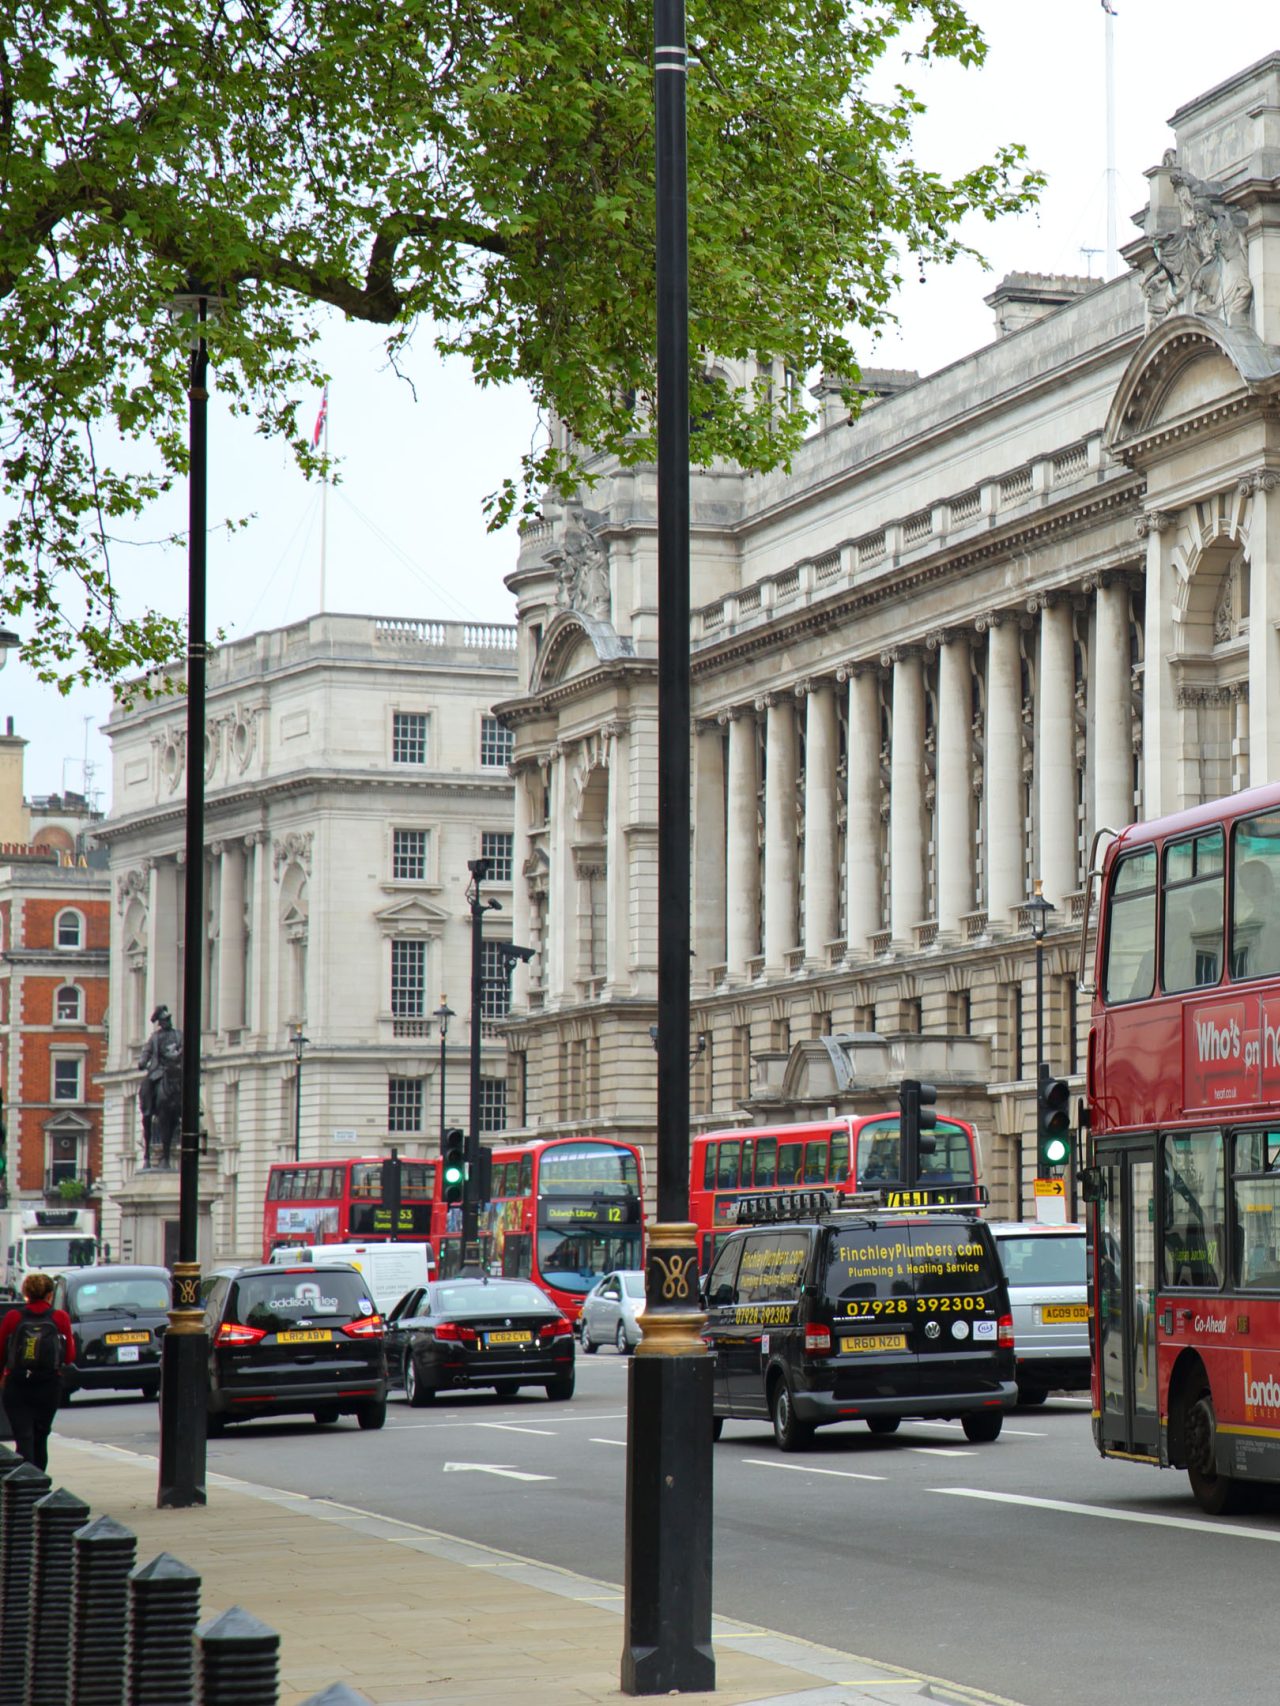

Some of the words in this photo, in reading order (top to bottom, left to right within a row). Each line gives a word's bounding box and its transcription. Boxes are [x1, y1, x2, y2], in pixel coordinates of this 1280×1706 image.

[1197, 1017, 1241, 1063] Who's
[1244, 1040, 1260, 1067] on
[1214, 1087, 1237, 1100] heart.co.uk
[608, 1208, 622, 1222] 12
[840, 1242, 984, 1262] FinchleyPlumbers.com
[848, 1265, 894, 1278] Plumbing
[907, 1263, 944, 1275] Heating
[946, 1262, 980, 1273] Service
[269, 1296, 313, 1309] addison
[321, 1295, 339, 1306] lee
[847, 1299, 908, 1316] 07928
[917, 1297, 985, 1313] 392303
[1046, 1308, 1071, 1318] AG09
[1194, 1315, 1227, 1333] Go-Ahead
[283, 1331, 305, 1342] LR12
[307, 1330, 326, 1340] ABV
[846, 1337, 876, 1349] LR60
